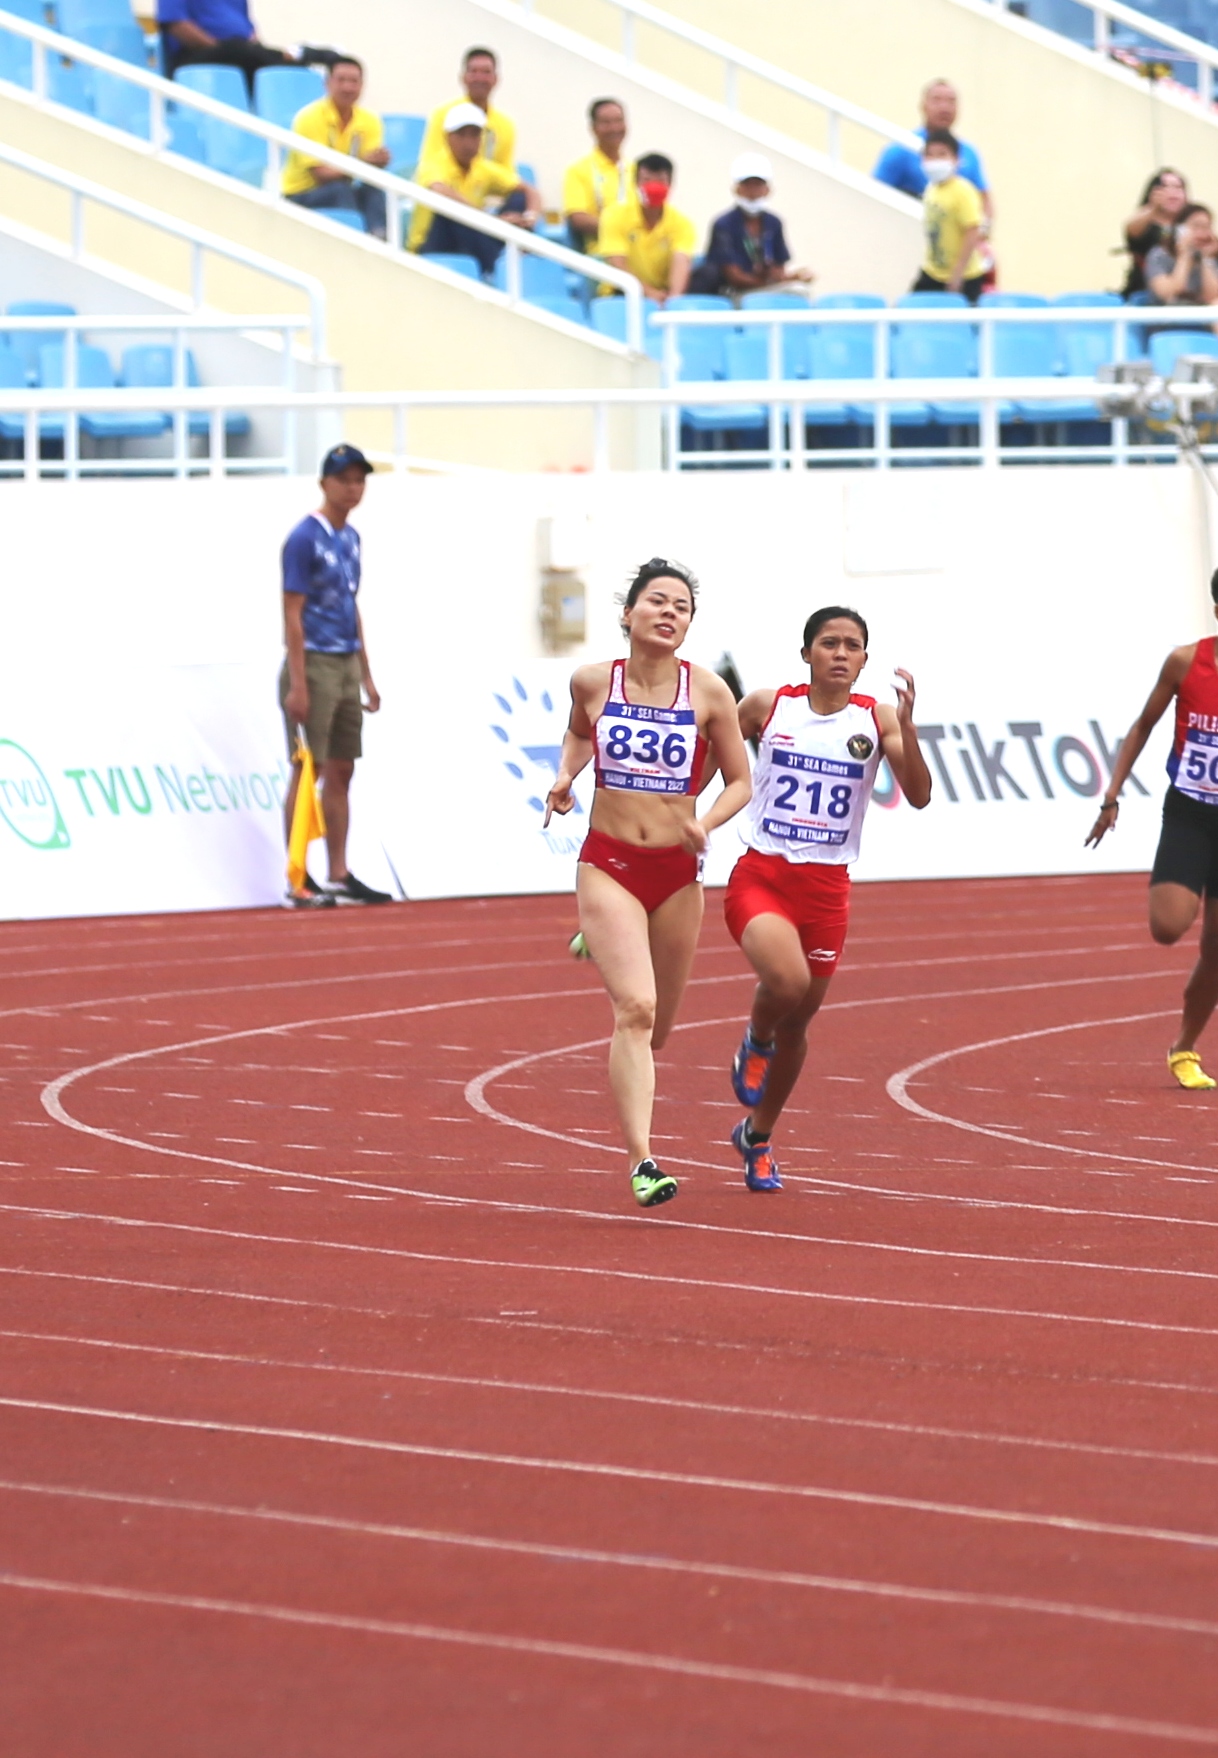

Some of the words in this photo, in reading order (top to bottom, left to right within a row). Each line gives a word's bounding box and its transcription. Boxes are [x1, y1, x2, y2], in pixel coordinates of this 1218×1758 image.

[606, 725, 687, 768] 836
[803, 756, 820, 772] SEA
[821, 761, 848, 775] Games
[915, 718, 1152, 803] TikTok
[62, 764, 153, 817] TVU
[774, 775, 852, 819] 218
